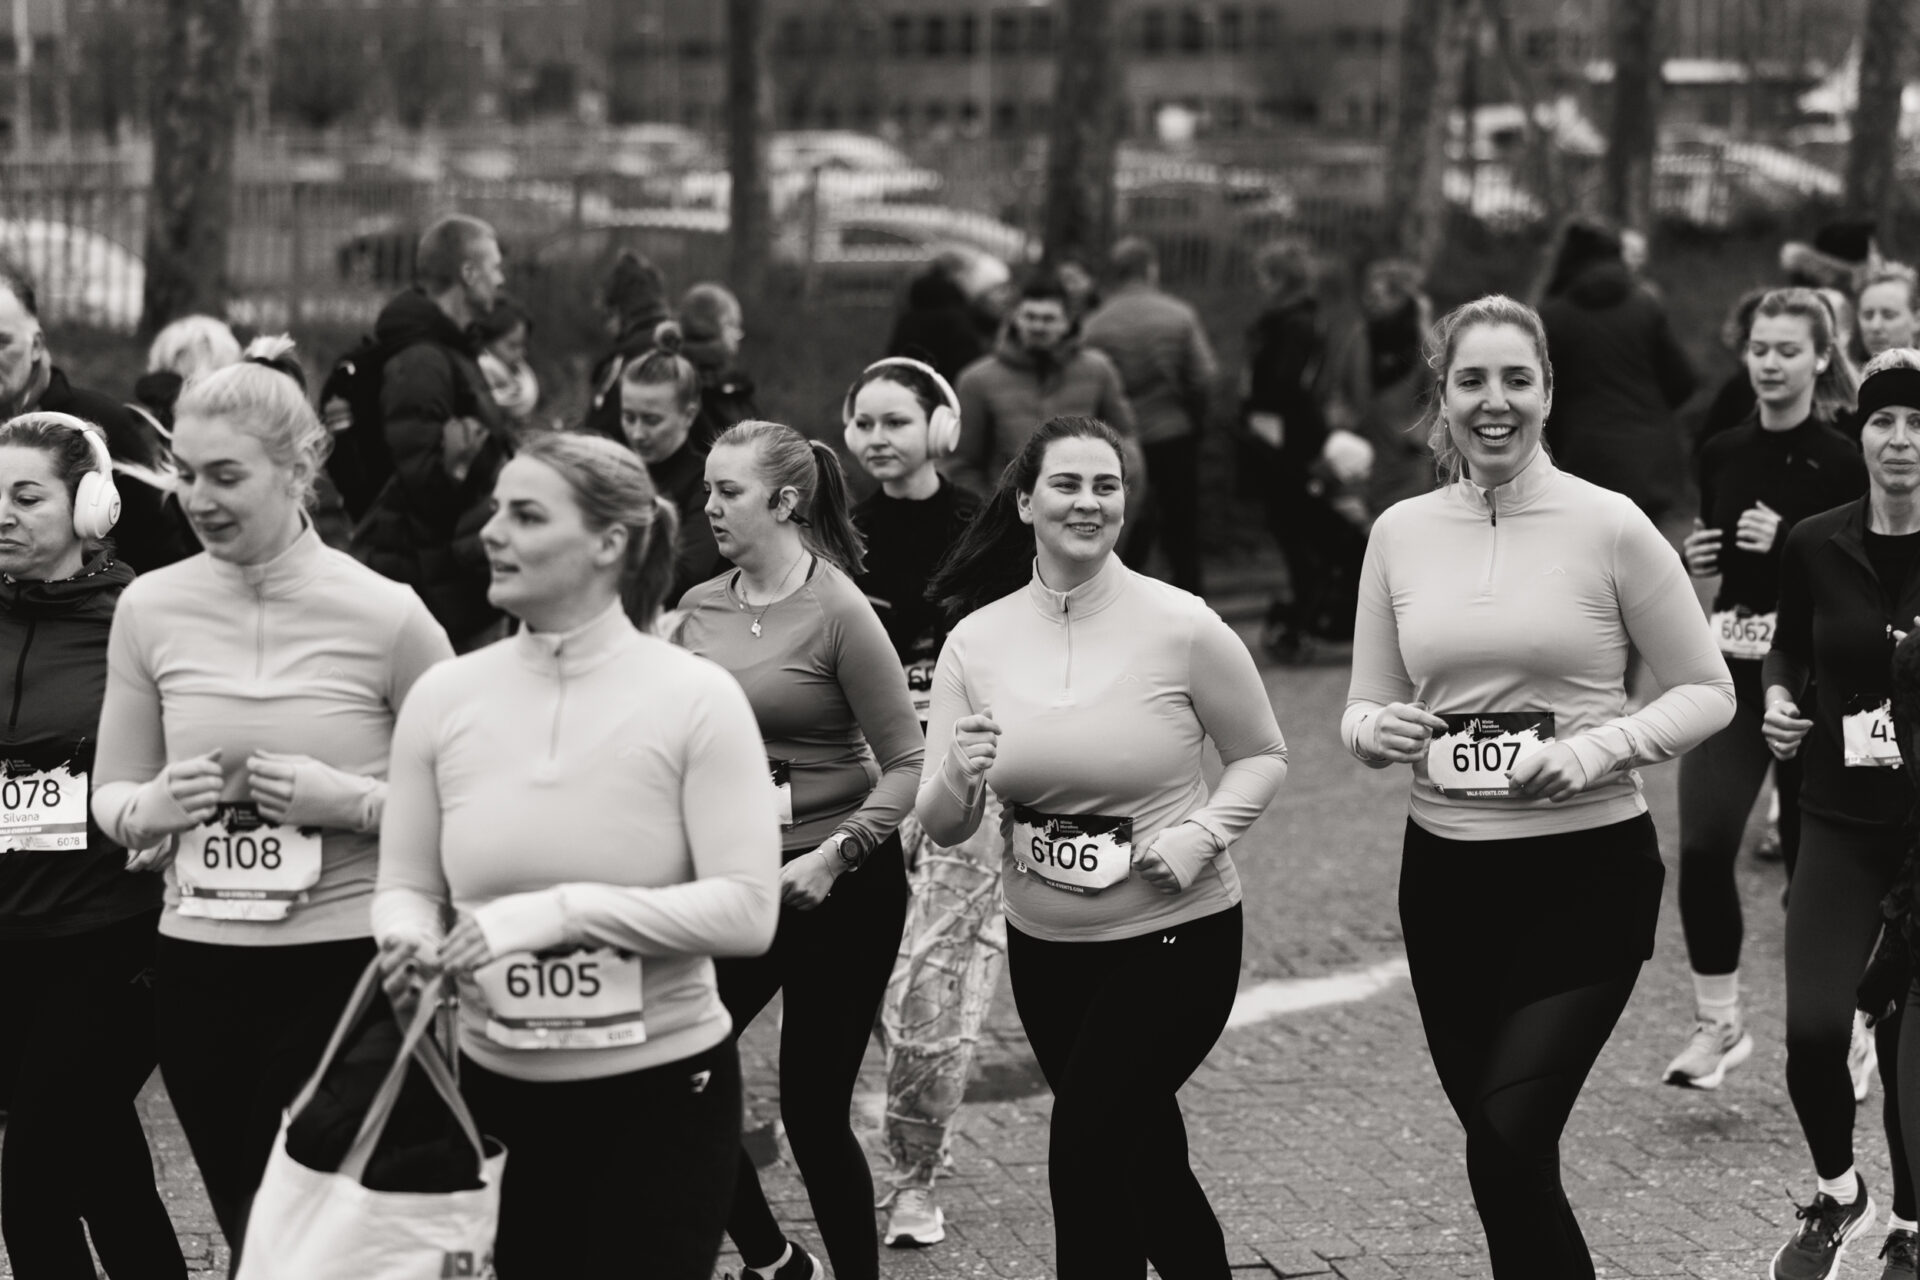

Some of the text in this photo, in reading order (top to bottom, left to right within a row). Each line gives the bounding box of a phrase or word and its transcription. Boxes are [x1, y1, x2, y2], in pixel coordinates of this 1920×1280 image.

[1722, 619, 1771, 643] 6062
[1453, 742, 1521, 773] 6107
[3, 813, 40, 824] Silvana
[57, 836, 80, 847] 6078
[203, 836, 282, 870] 6108
[1031, 836, 1099, 872] 6106
[506, 963, 601, 998] 6105
